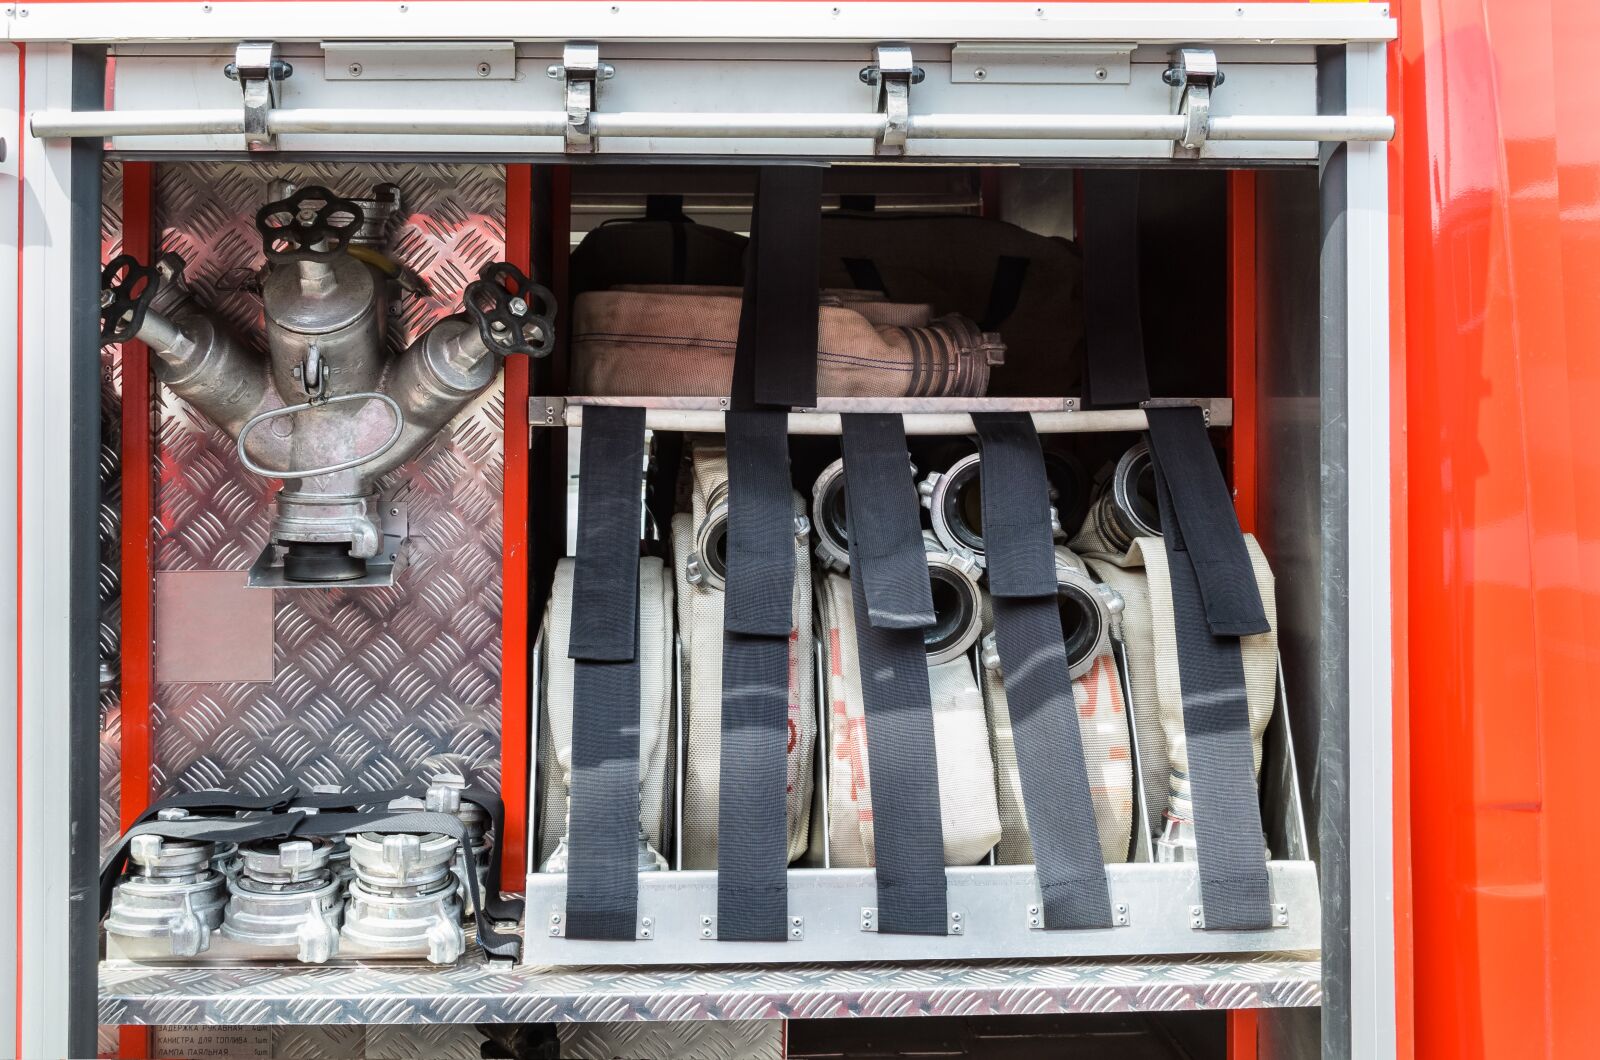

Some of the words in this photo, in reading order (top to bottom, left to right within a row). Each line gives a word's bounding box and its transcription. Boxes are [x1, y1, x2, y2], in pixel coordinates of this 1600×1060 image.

[158, 1036, 195, 1044] КАНИСТРА
[198, 1036, 213, 1045] ДЛЯ
[216, 1036, 248, 1044] ТОПЛИВА
[158, 1048, 185, 1056] ЛАМПА
[187, 1048, 229, 1056] ПАЯЛЬНАЯ
